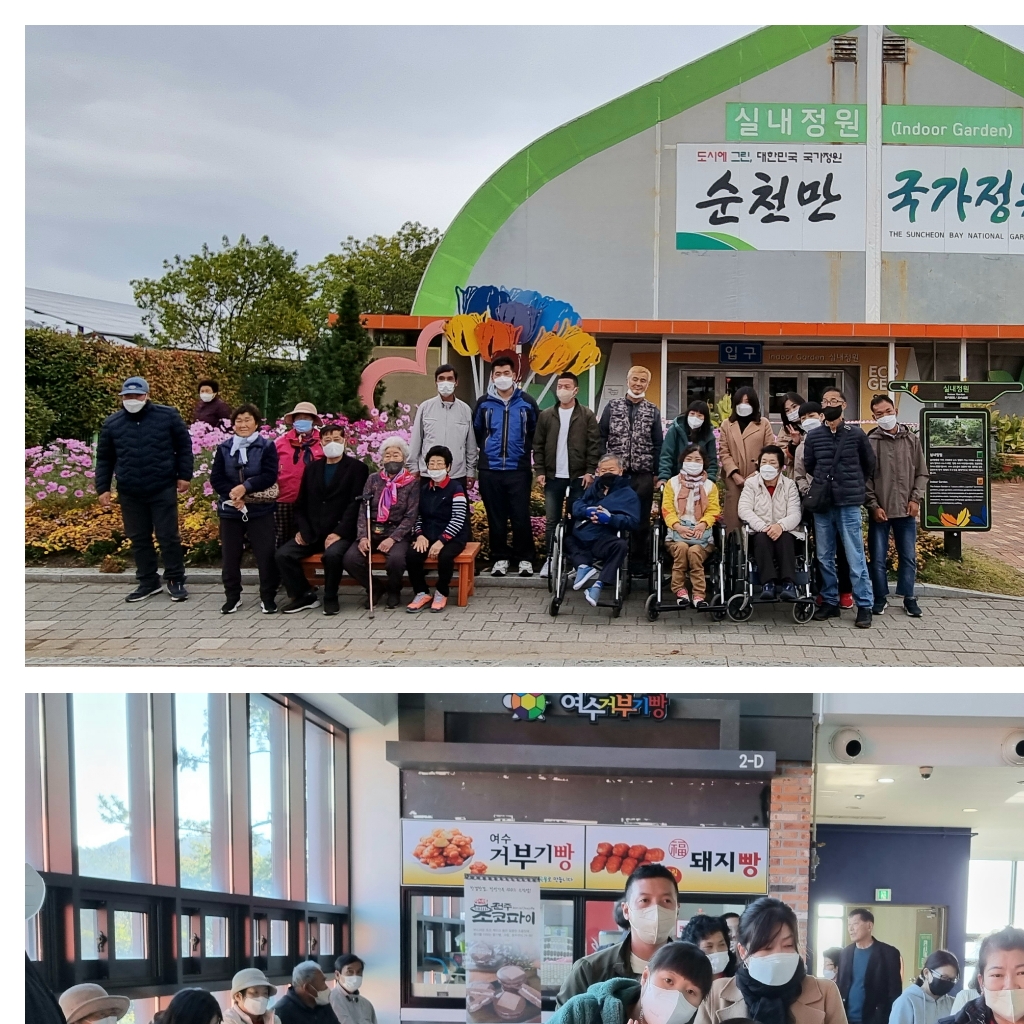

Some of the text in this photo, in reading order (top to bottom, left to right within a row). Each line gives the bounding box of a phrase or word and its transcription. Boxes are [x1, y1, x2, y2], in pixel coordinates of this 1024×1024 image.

[734, 107, 860, 138] 실내정원
[891, 121, 1013, 139] (Indoor Garden)
[697, 151, 843, 164] 도시에 그린, 대한민국 국가정원
[695, 169, 842, 226] 순천만
[889, 230, 903, 238] THE
[906, 231, 945, 239] SUNCHEON
[967, 232, 1005, 240] NATIONAL
[725, 346, 757, 360] 입구
[739, 754, 764, 769] 2-D
[489, 833, 511, 844] 여수
[489, 843, 575, 871] 거부기빵
